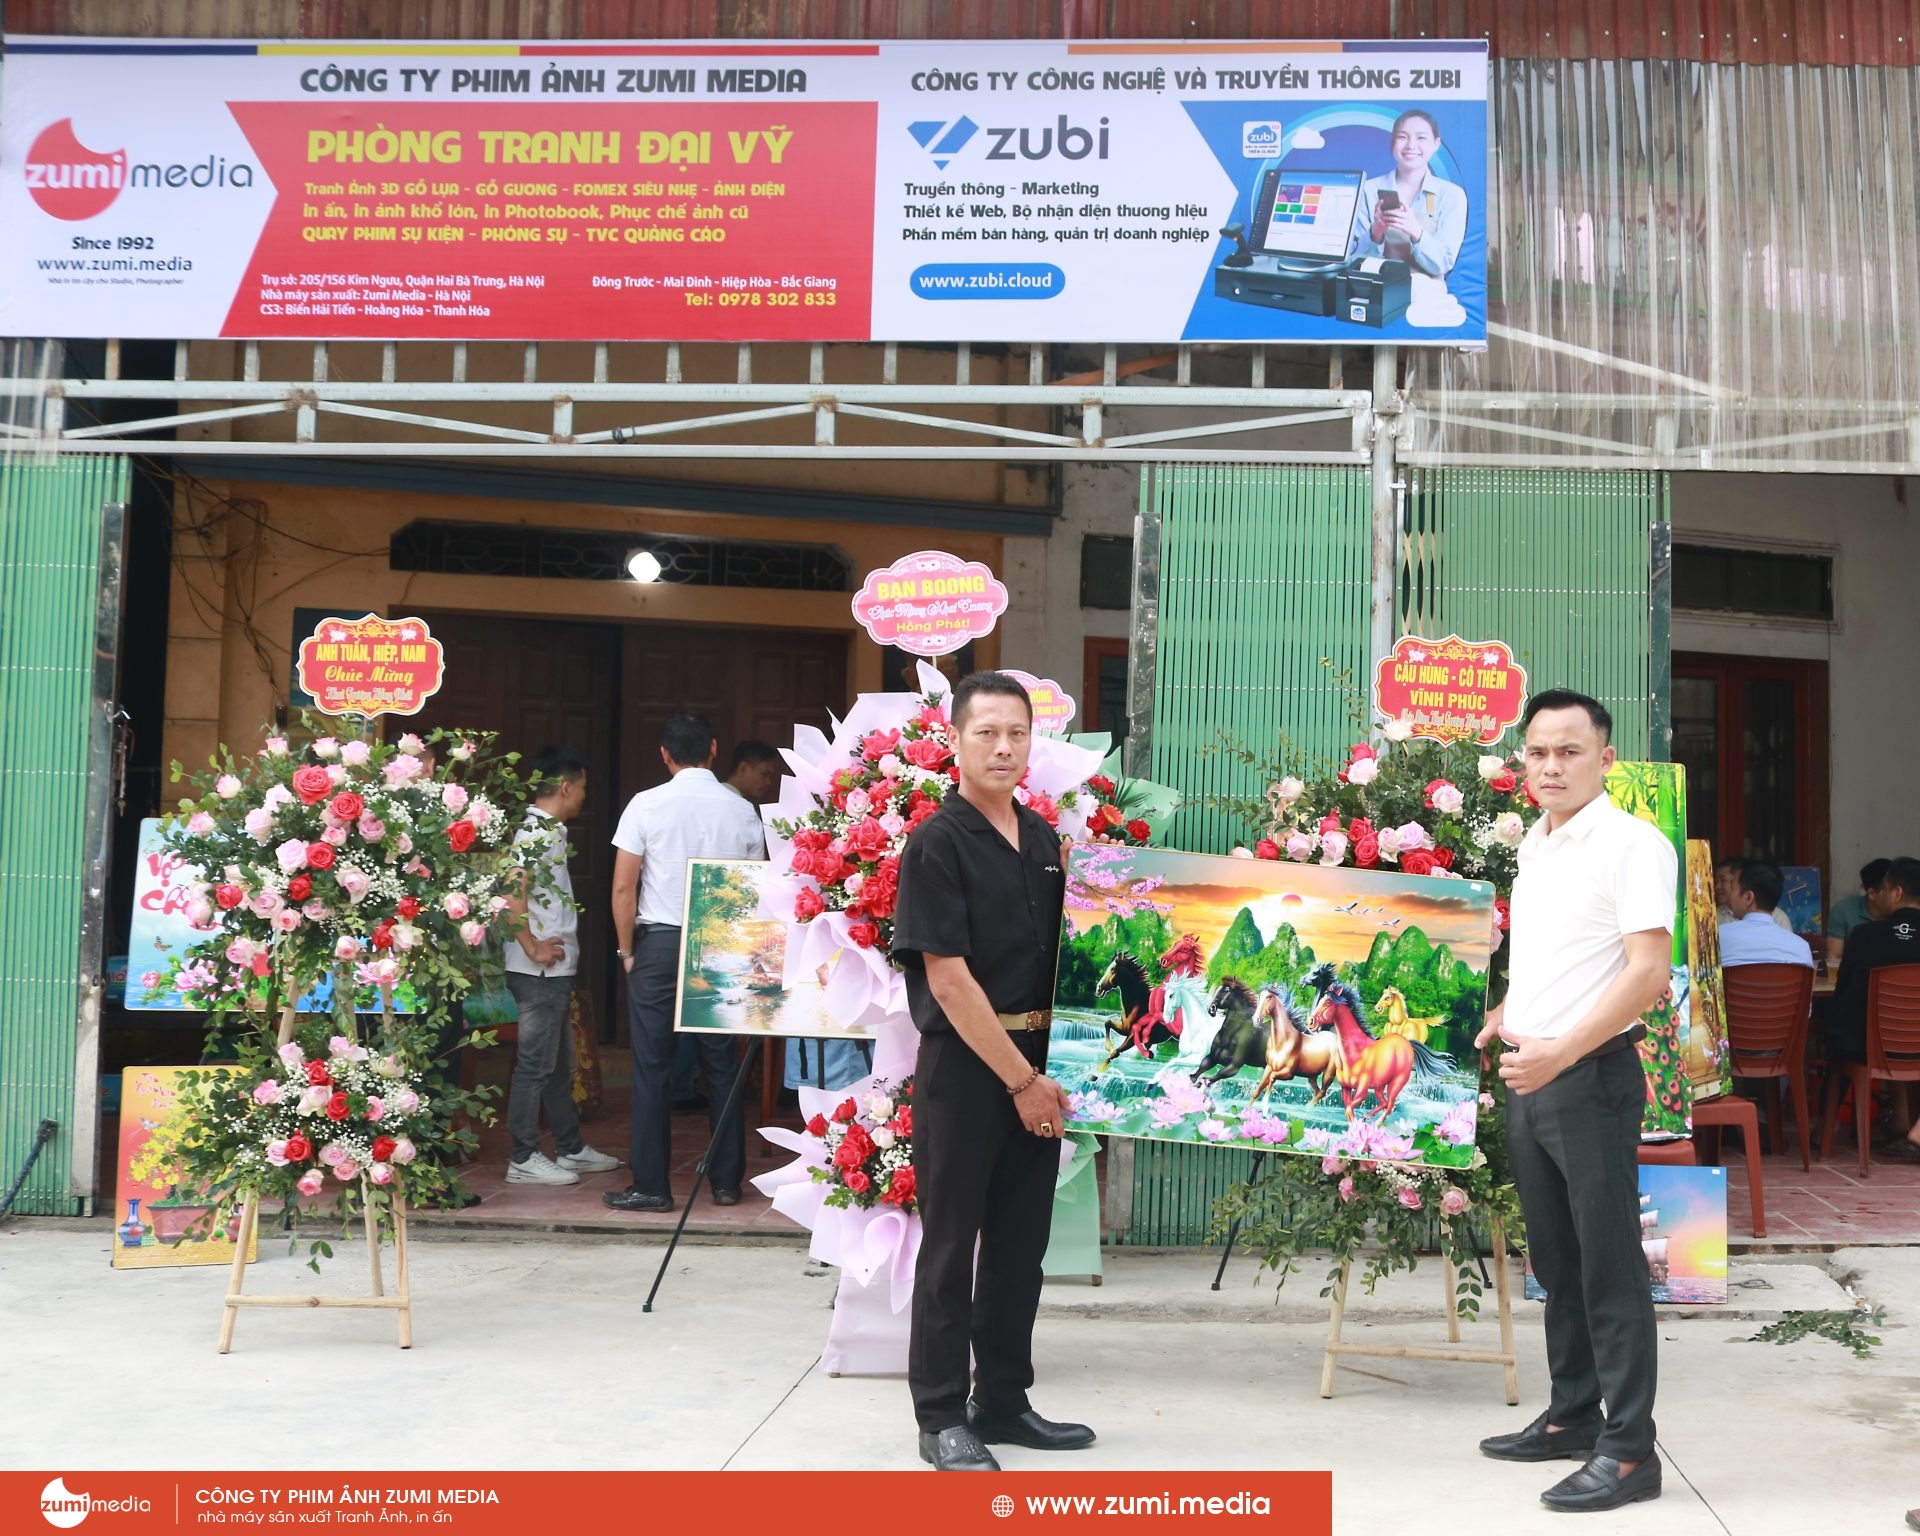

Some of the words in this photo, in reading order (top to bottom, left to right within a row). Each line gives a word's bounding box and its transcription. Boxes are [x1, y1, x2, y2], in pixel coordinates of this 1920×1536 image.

[300, 63, 388, 93] CÔNG
[399, 69, 440, 93] TY
[452, 69, 531, 93] PHIM
[541, 62, 605, 93] ẢNH
[616, 69, 696, 93] ZUMI
[706, 69, 807, 93] MEDIA
[911, 68, 978, 92] CÔNG
[987, 72, 1018, 91] TY
[1027, 68, 1095, 91] CÔNG
[1103, 67, 1165, 94] NGHỆ
[1174, 67, 1207, 90] VÀ
[1215, 63, 1309, 90] TRUYỀN
[1318, 66, 1400, 89] THÔNG
[1410, 69, 1461, 89] ZUBI
[984, 114, 1109, 161] zubi
[307, 123, 462, 164] PHÒNG
[478, 130, 620, 164] TRANH
[636, 131, 711, 172] ĐẠI
[728, 124, 794, 164] VỸ
[304, 182, 344, 195] Tranh
[348, 179, 376, 195] Ảnh
[380, 183, 400, 195] 3D
[404, 179, 427, 196] GỖ
[475, 179, 499, 196] GỖ
[573, 183, 628, 196] FOMEX
[633, 181, 663, 196] SIÊU
[668, 183, 698, 199] NHẸ
[751, 181, 785, 199] ĐIỆN
[961, 182, 1005, 199] thông
[1022, 182, 1099, 198] Marketing
[303, 203, 318, 218] in
[354, 203, 369, 218] in
[411, 201, 443, 218] khổ
[484, 203, 499, 218] in
[504, 204, 604, 220] Photobook,
[610, 204, 651, 222] Phục
[657, 202, 687, 219] chế
[729, 204, 749, 219] cũ
[904, 203, 941, 218] Thiết
[946, 203, 965, 218] kế
[970, 205, 1007, 219] Web,
[1012, 204, 1032, 221] Bộ
[1037, 204, 1073, 220] nhận
[1079, 204, 1111, 220] diện
[1175, 204, 1207, 220] hiệu
[302, 226, 348, 243] QUAY
[354, 227, 396, 241] PHIM
[427, 224, 464, 244] KIỆN
[586, 228, 619, 242] TVC
[624, 224, 685, 243] QUẢNG
[690, 225, 726, 242] CÁO
[982, 228, 1007, 240] bán
[1012, 228, 1049, 243] hàng,
[1054, 227, 1088, 243] quản
[1094, 227, 1108, 242] trị
[1114, 227, 1157, 240] doanh
[1162, 227, 1209, 243] nghiệp
[72, 237, 111, 250] Since
[118, 237, 154, 250] 1992
[37, 256, 193, 272] www.zumi.media
[262, 274, 279, 287] Trụ
[300, 274, 346, 288] 205/156
[347, 274, 369, 286] Kim
[405, 275, 434, 288] Quận
[436, 275, 454, 286] Hai
[456, 275, 470, 286] Bà
[509, 276, 524, 287] Hà
[525, 275, 545, 288] Nội
[592, 276, 621, 290] Đông
[663, 276, 684, 288] Mai
[686, 276, 712, 288] Đình
[722, 276, 747, 290] Hiệp
[750, 276, 771, 288] Hòa
[781, 275, 801, 288] Bắc
[803, 276, 837, 290] Giang
[919, 273, 1052, 288] www.zubi.cloud
[261, 288, 282, 300] Nhà
[284, 289, 309, 302] máy
[311, 289, 330, 300] sản
[332, 288, 360, 300] xuất:
[362, 289, 390, 300] Zumi
[392, 290, 426, 300] Media
[435, 290, 450, 301] Hà
[452, 290, 471, 303] Nội
[685, 293, 713, 306] Tel:
[719, 293, 761, 306] 0978
[767, 293, 799, 306] 302
[804, 293, 837, 306] 833
[260, 304, 283, 315] CS3:
[285, 301, 310, 315] Biển
[332, 303, 355, 315] Tiến
[402, 305, 424, 316] Hóa
[433, 305, 466, 316] Thanh
[469, 305, 490, 316] Hóa
[877, 580, 916, 602] BẠN
[921, 576, 986, 597] BOONG
[316, 644, 338, 661] ANH
[373, 641, 399, 666] HIỆP,
[401, 644, 426, 663] NAM
[325, 665, 363, 682] Chúc
[1394, 660, 1416, 686] CẬU
[1419, 662, 1449, 686] HÙNG
[1459, 665, 1474, 688] CÔ
[1477, 667, 1508, 690] THÊM
[1410, 688, 1444, 708] VĨNH
[1448, 691, 1487, 711] PHÚC
